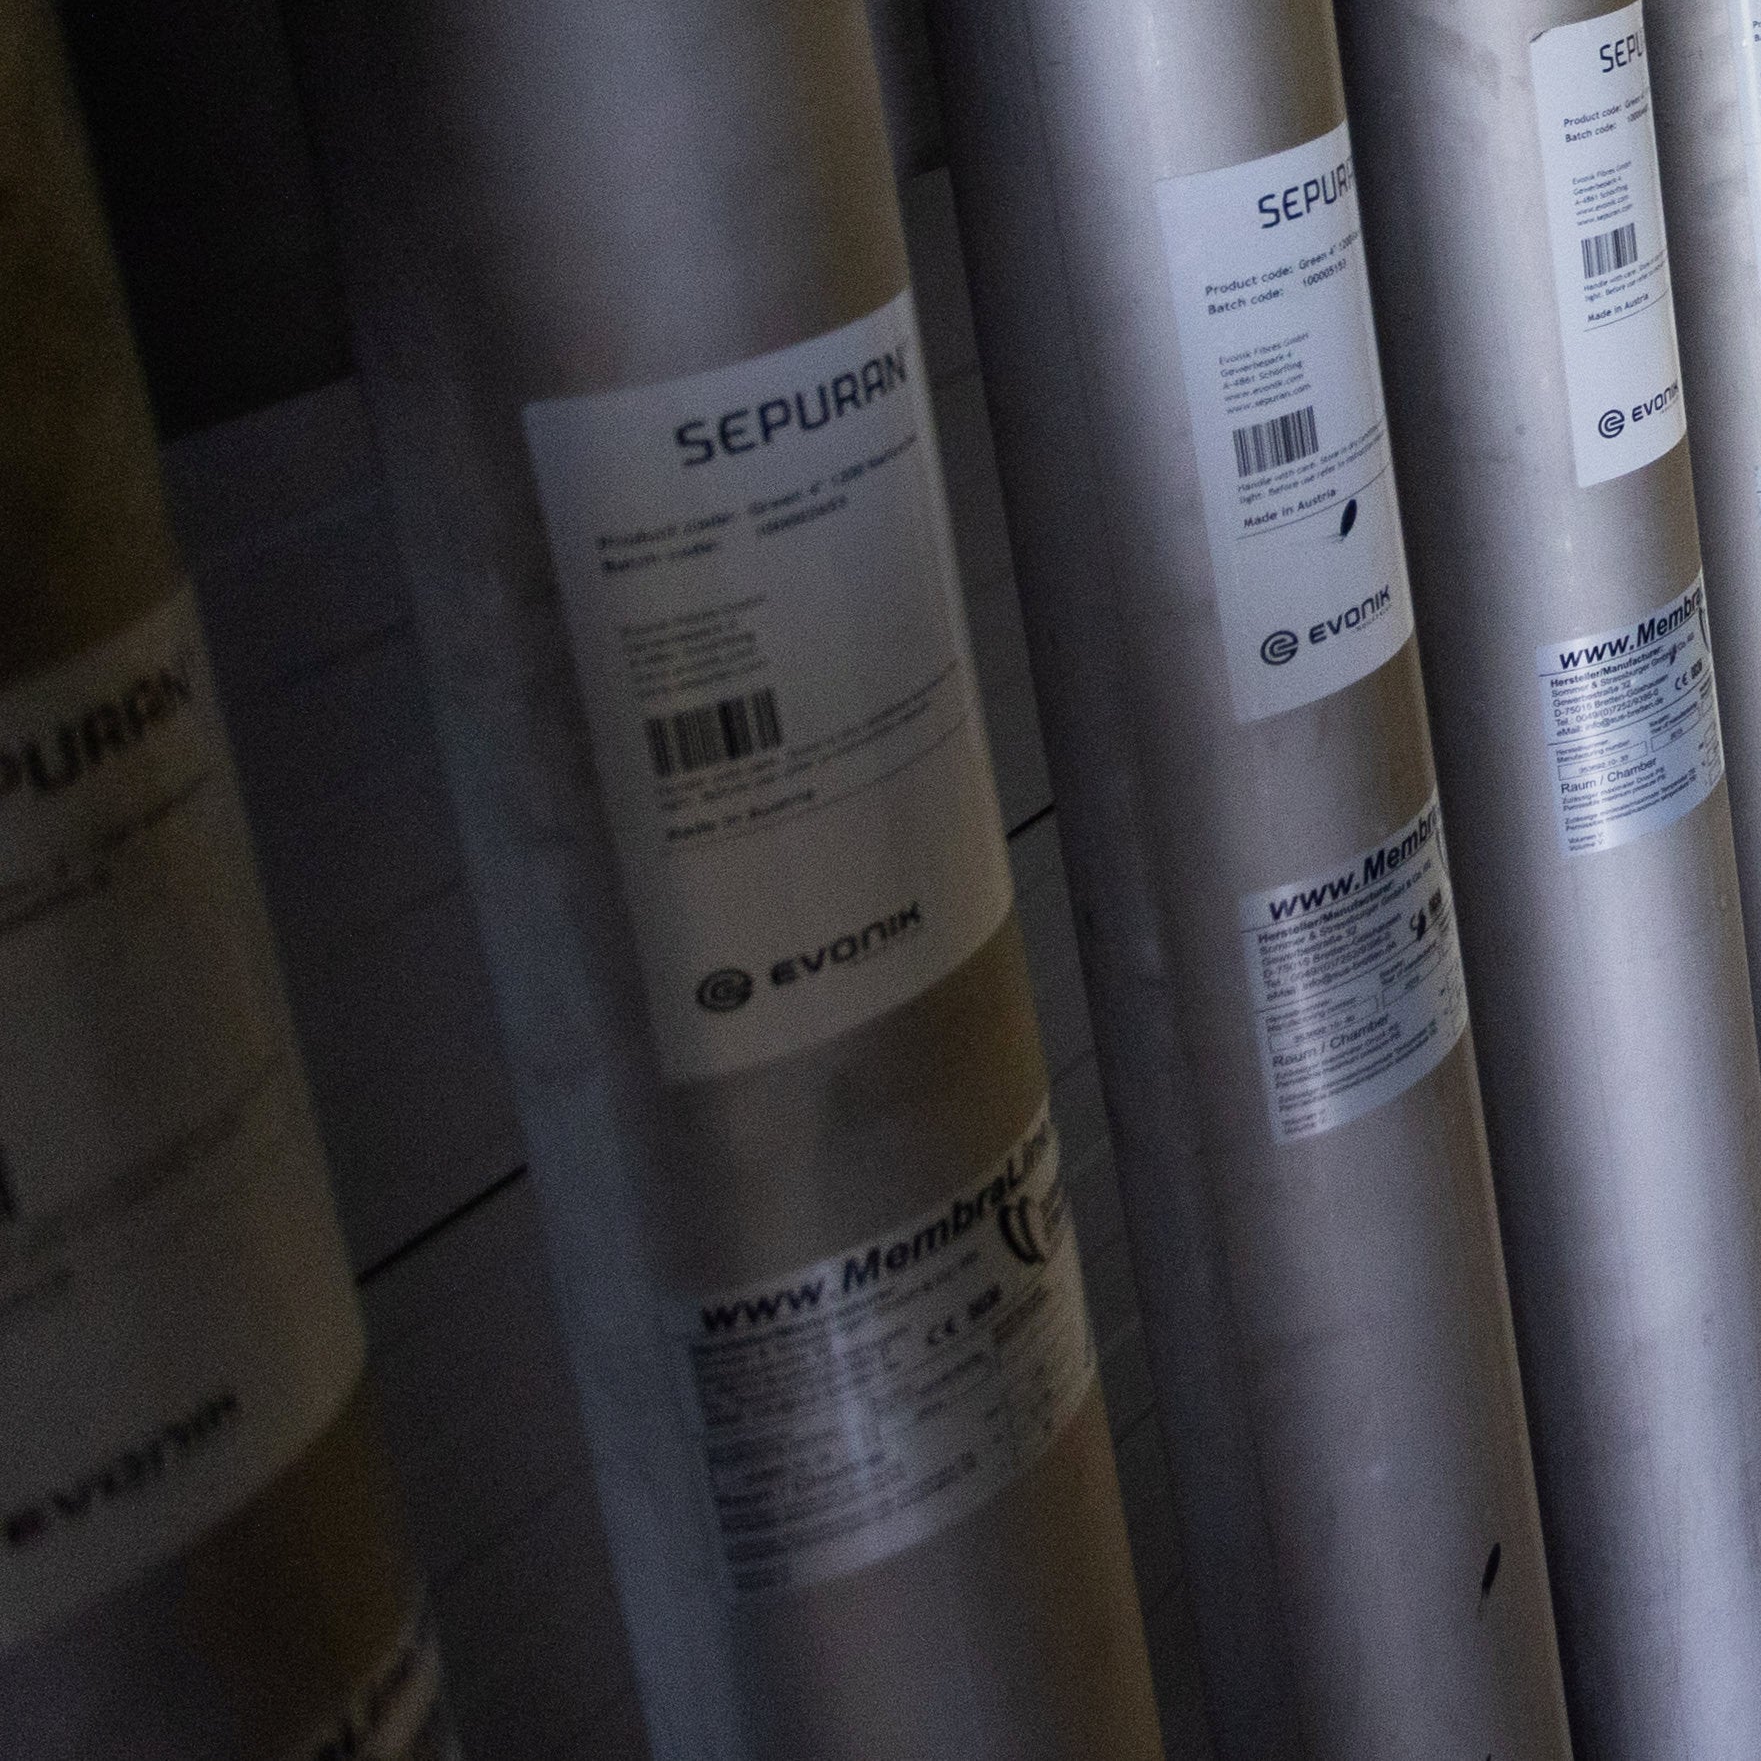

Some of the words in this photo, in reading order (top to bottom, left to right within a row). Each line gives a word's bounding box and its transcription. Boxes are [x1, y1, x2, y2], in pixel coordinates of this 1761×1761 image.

[1563, 111, 1600, 127] Product
[1602, 105, 1622, 118] code:
[1565, 129, 1593, 143] Batch
[1594, 122, 1616, 135] code:
[1205, 275, 1258, 296] Product
[1260, 265, 1294, 283] code:
[1207, 297, 1247, 316] Batch
[1250, 288, 1284, 305] code:
[1588, 310, 1612, 323] Made
[1614, 303, 1623, 313] in
[1624, 293, 1649, 310] Austria
[674, 343, 908, 469] SEPURAN
[1244, 512, 1277, 528] Made
[1282, 506, 1293, 517] in
[1297, 489, 1336, 511] Austria
[1561, 780, 1597, 794] Raum
[1607, 758, 1657, 782] Chamber
